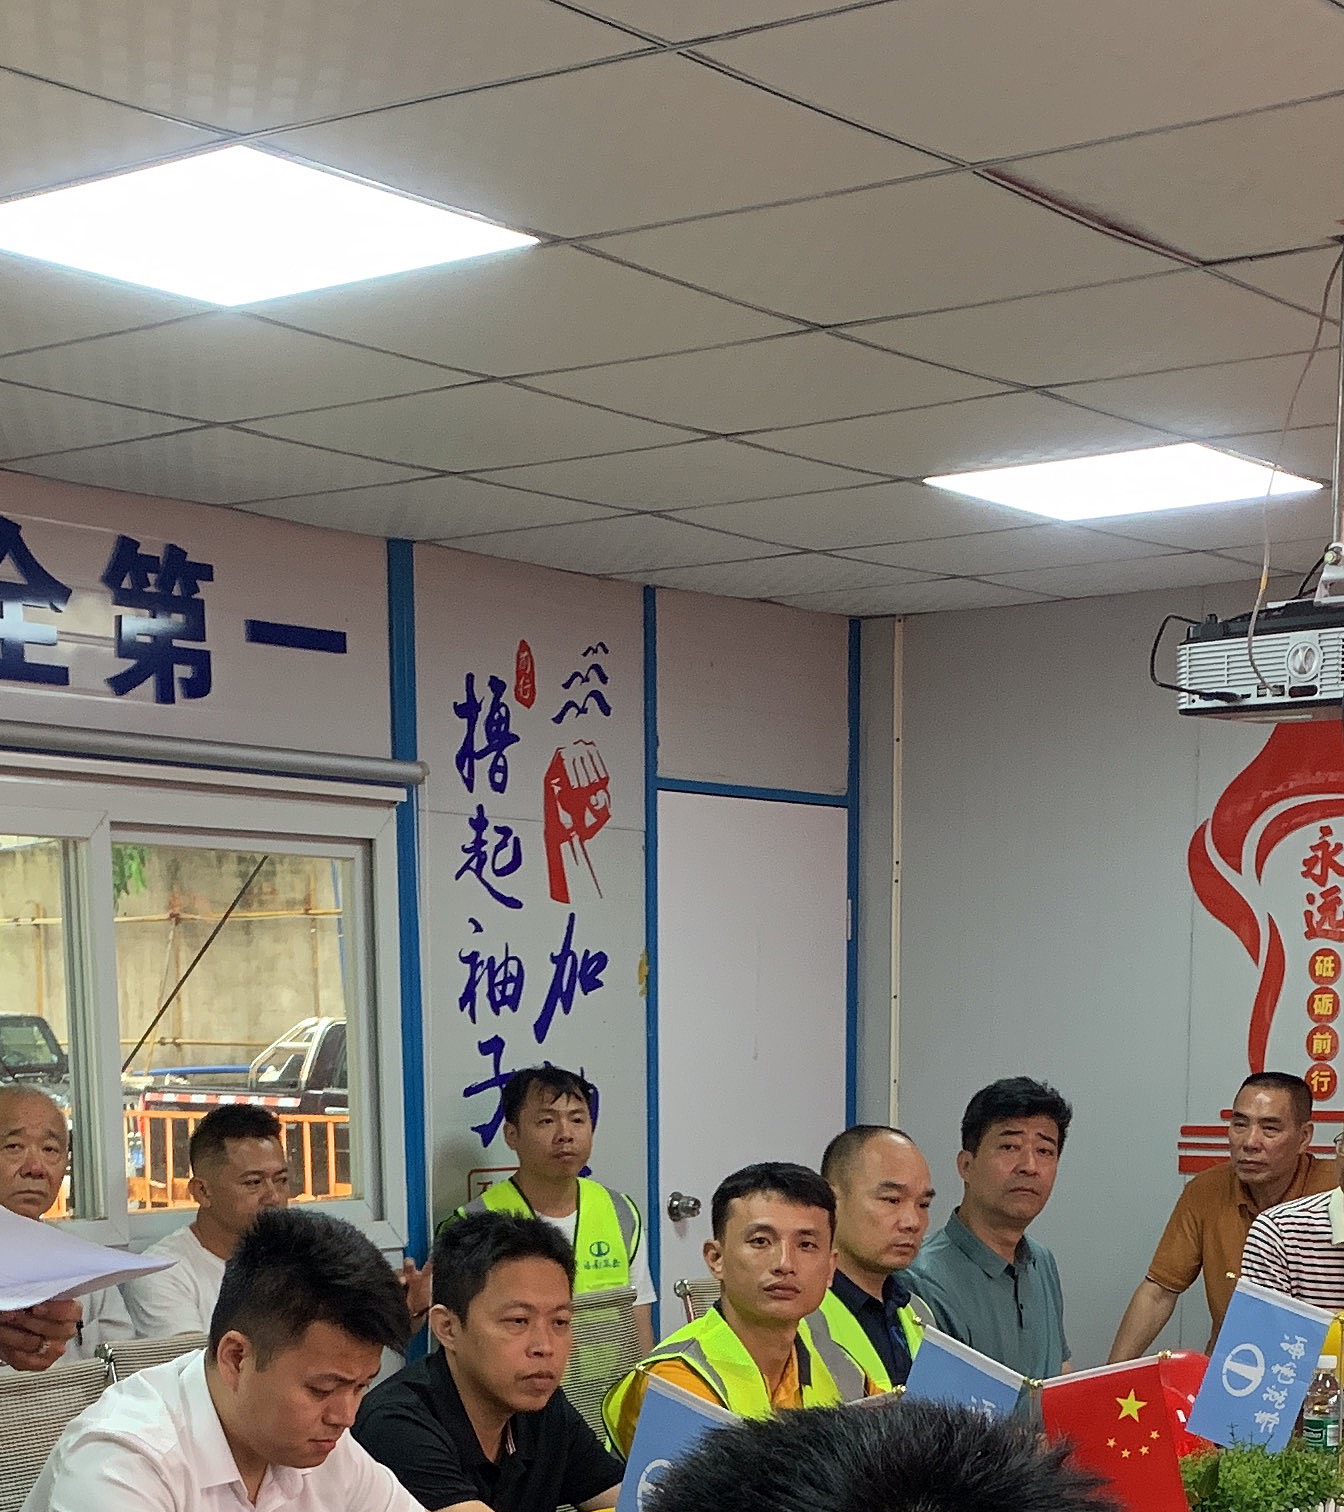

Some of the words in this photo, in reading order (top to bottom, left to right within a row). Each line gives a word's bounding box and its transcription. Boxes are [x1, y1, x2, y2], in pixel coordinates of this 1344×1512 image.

[453, 672, 524, 1148] 撸起袖子
[1309, 953, 1337, 1095] 砥砺前行
